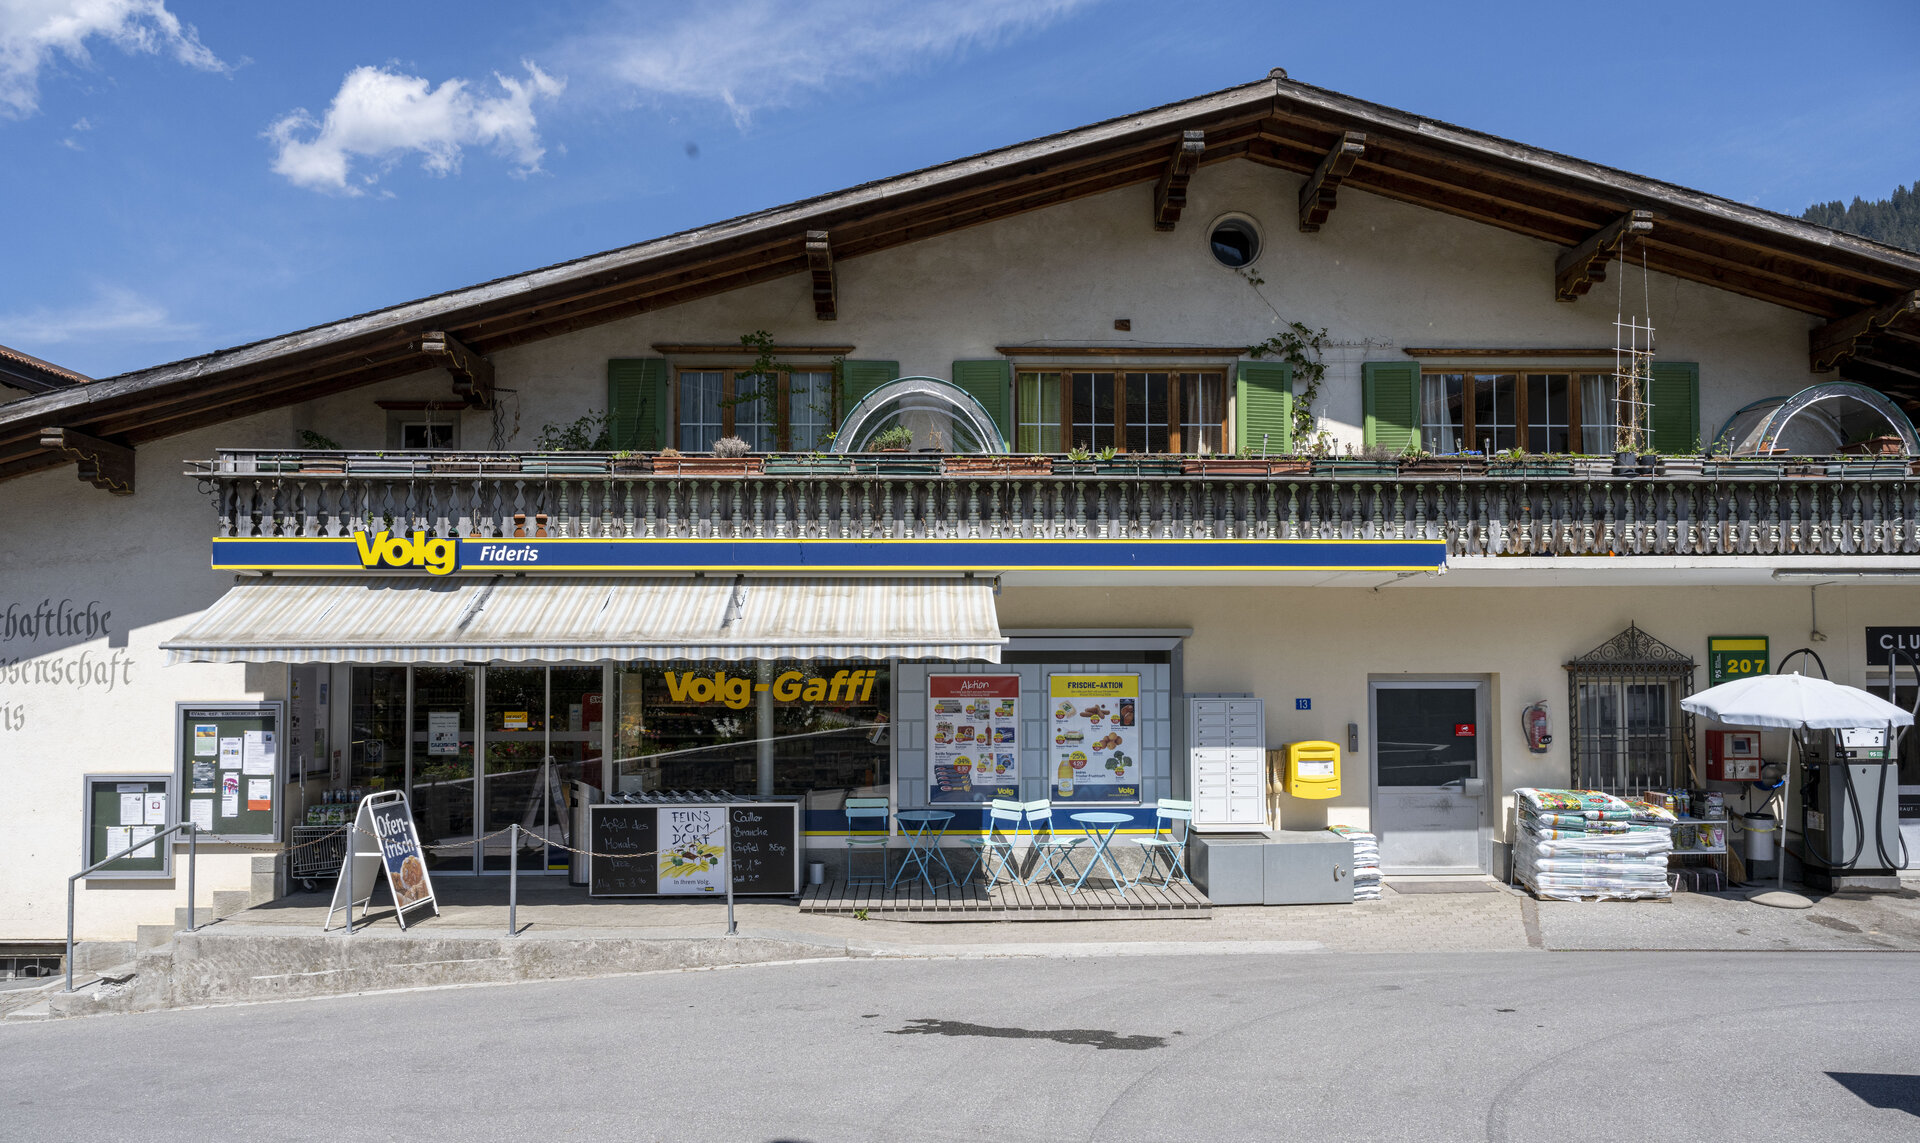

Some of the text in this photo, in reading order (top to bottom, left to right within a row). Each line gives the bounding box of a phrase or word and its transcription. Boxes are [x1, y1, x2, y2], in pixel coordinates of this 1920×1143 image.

[354, 530, 456, 576] Volg
[479, 545, 539, 562] Fideris
[1880, 634, 1920, 650] CLU
[1727, 659, 1766, 673] 207
[664, 670, 877, 710] Volg-Gaffi
[961, 680, 990, 691] Aktion
[1067, 681, 1124, 689] FRISCHE-AKTION
[1298, 699, 1309, 709] 13
[0, 701, 25, 732] is
[1846, 736, 1850, 744] 1
[1874, 736, 1879, 744] 2
[997, 787, 1014, 796] Volg
[1118, 786, 1135, 795] Volg
[376, 813, 409, 838] Ofen-
[672, 823, 710, 834] VOM
[384, 833, 415, 859] frisch
[671, 833, 711, 846] DORF
